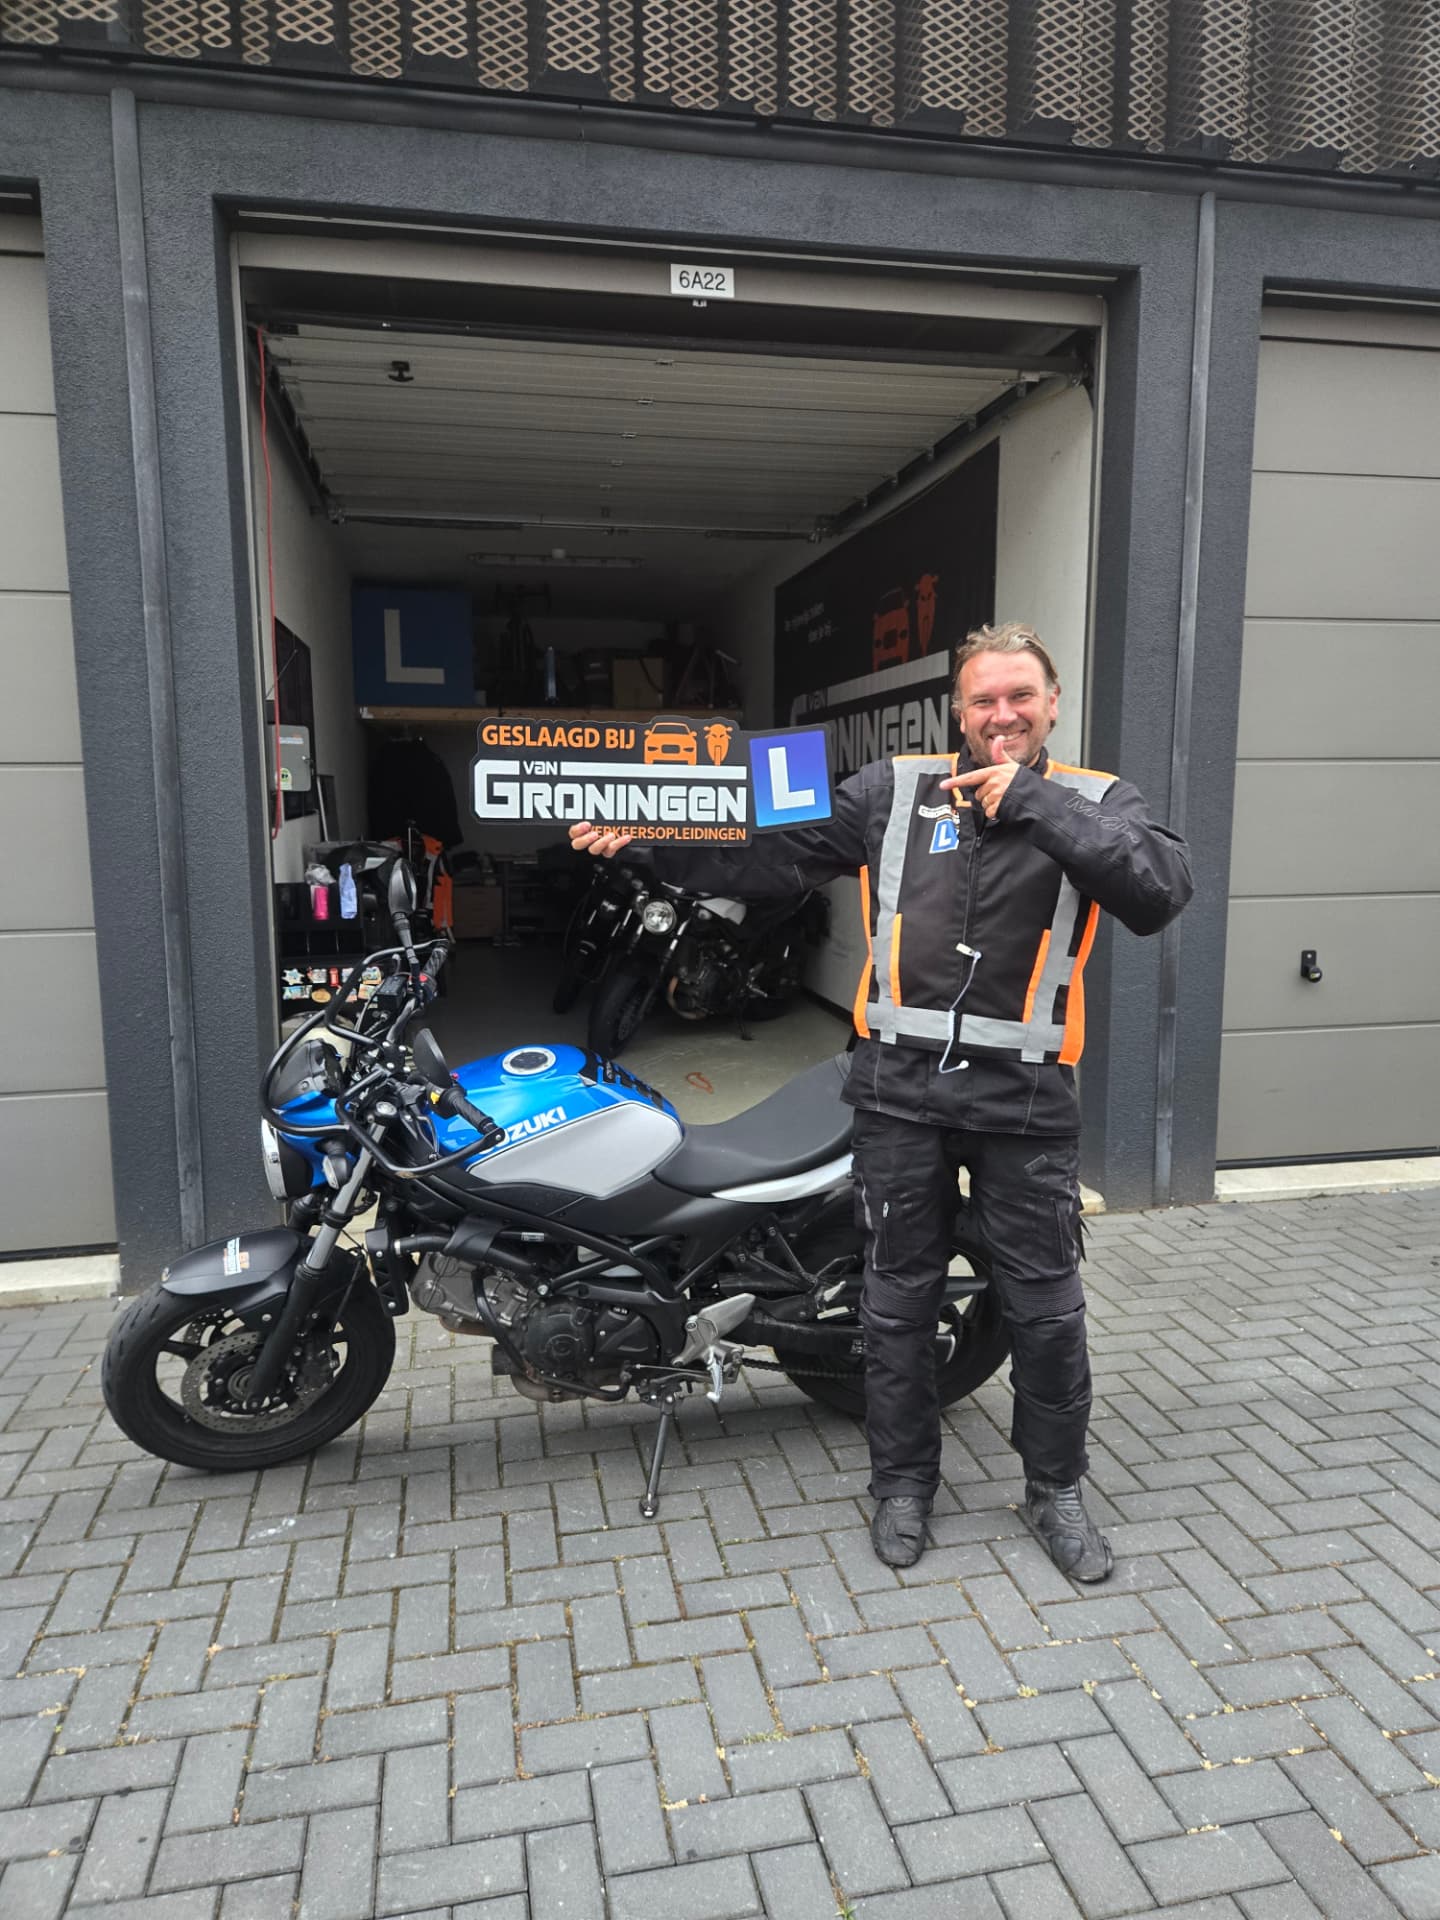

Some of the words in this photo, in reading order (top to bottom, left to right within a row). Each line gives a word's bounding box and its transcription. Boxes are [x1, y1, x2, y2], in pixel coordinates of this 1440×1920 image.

[679, 270, 726, 291] 6A22
[384, 609, 445, 684] L
[481, 724, 601, 749] GESLAAGD
[605, 728, 635, 749] BIJ
[768, 746, 815, 810] L
[479, 1106, 567, 1155] ZUKI
